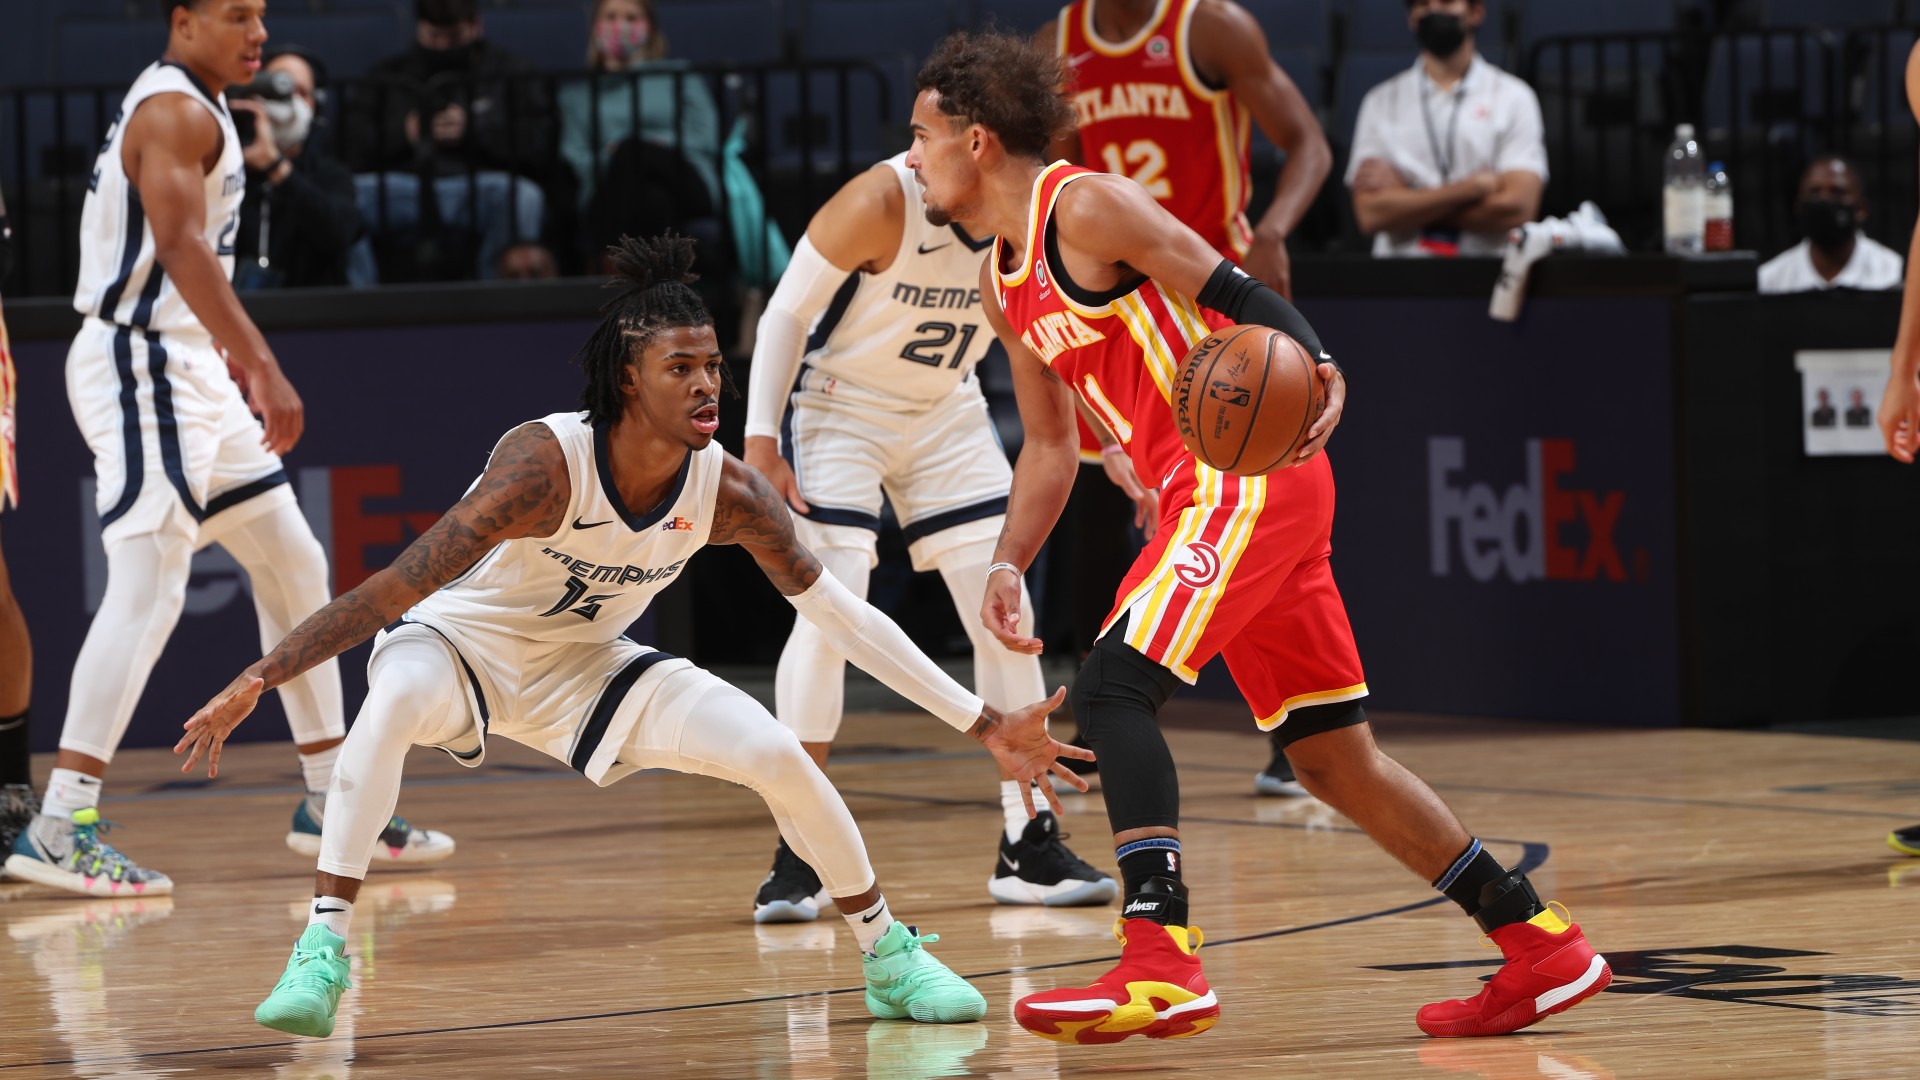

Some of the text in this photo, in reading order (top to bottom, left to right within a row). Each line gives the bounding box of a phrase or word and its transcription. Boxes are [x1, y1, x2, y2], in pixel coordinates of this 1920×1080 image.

[1074, 83, 1192, 129] TLANTA
[1101, 138, 1173, 198] 12
[892, 282, 982, 309] MEMP
[899, 321, 979, 369] 21
[1178, 337, 1223, 438] SPALDING
[661, 516, 694, 532] edEx
[1428, 436, 1628, 584] FedEx
